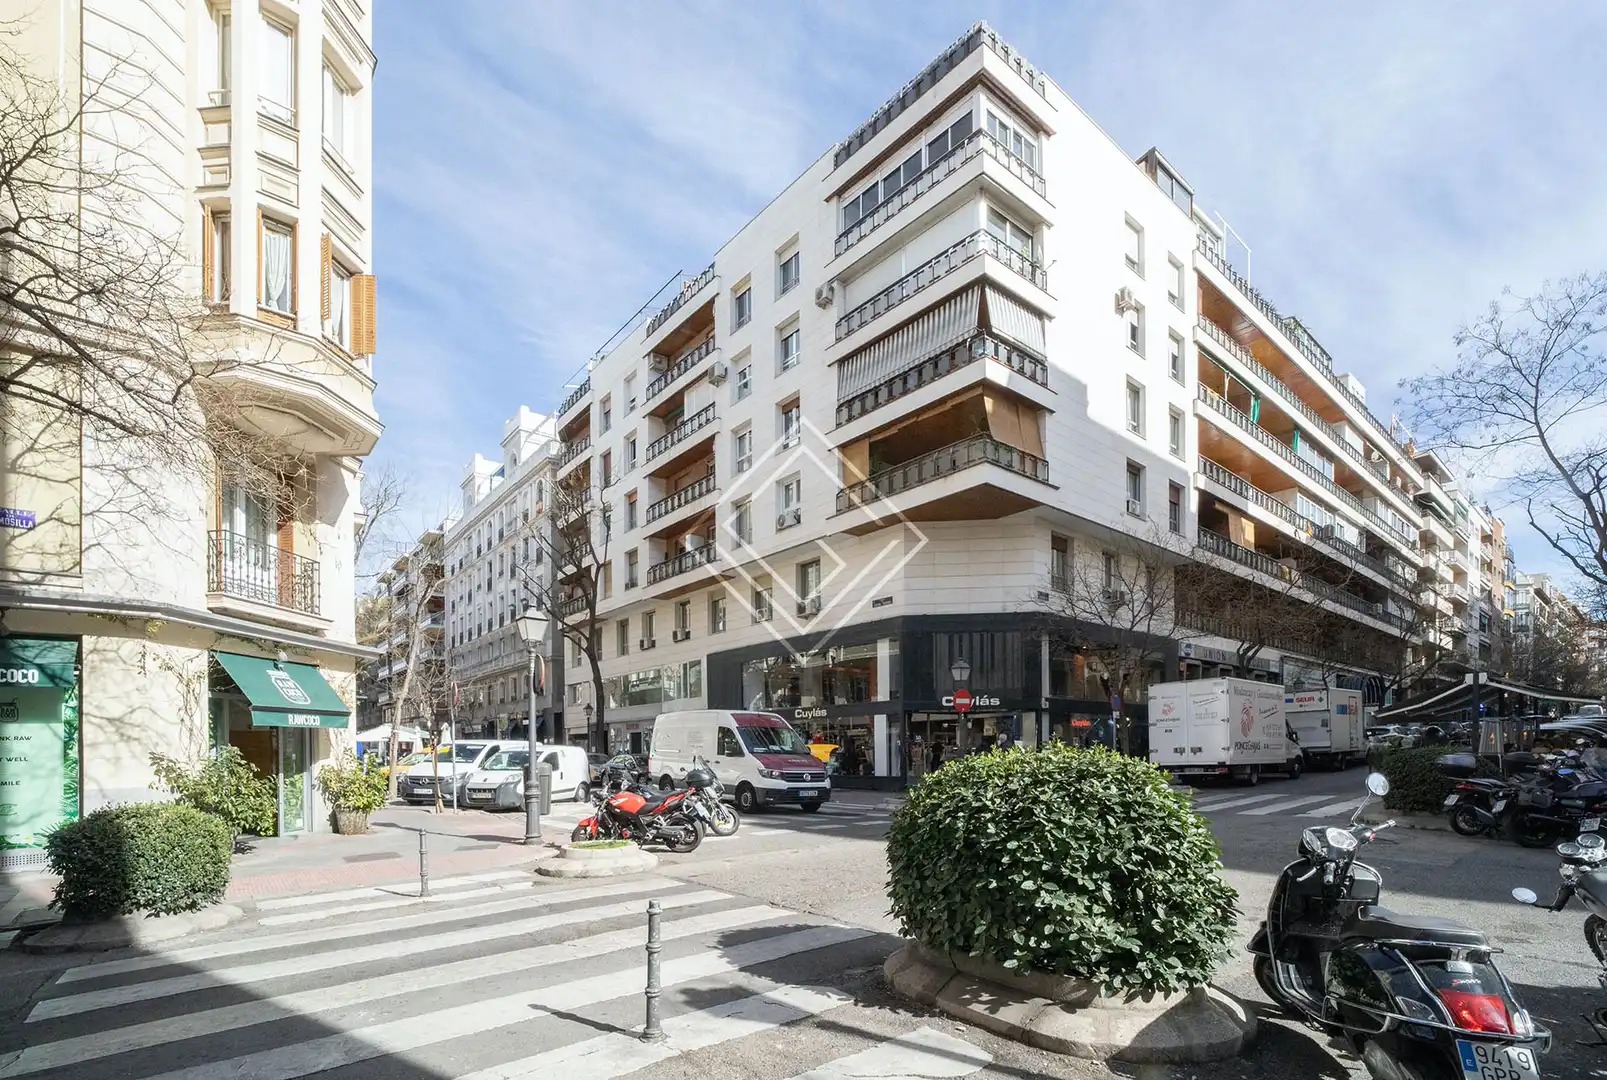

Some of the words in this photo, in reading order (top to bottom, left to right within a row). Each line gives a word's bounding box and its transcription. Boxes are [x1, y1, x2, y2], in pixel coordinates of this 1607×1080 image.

[0, 668, 39, 684] COCO
[942, 695, 1001, 708] Cylás
[288, 713, 321, 726] RAWCOCO
[795, 707, 828, 719] Cuylás
[1475, 1045, 1531, 1070] 9419
